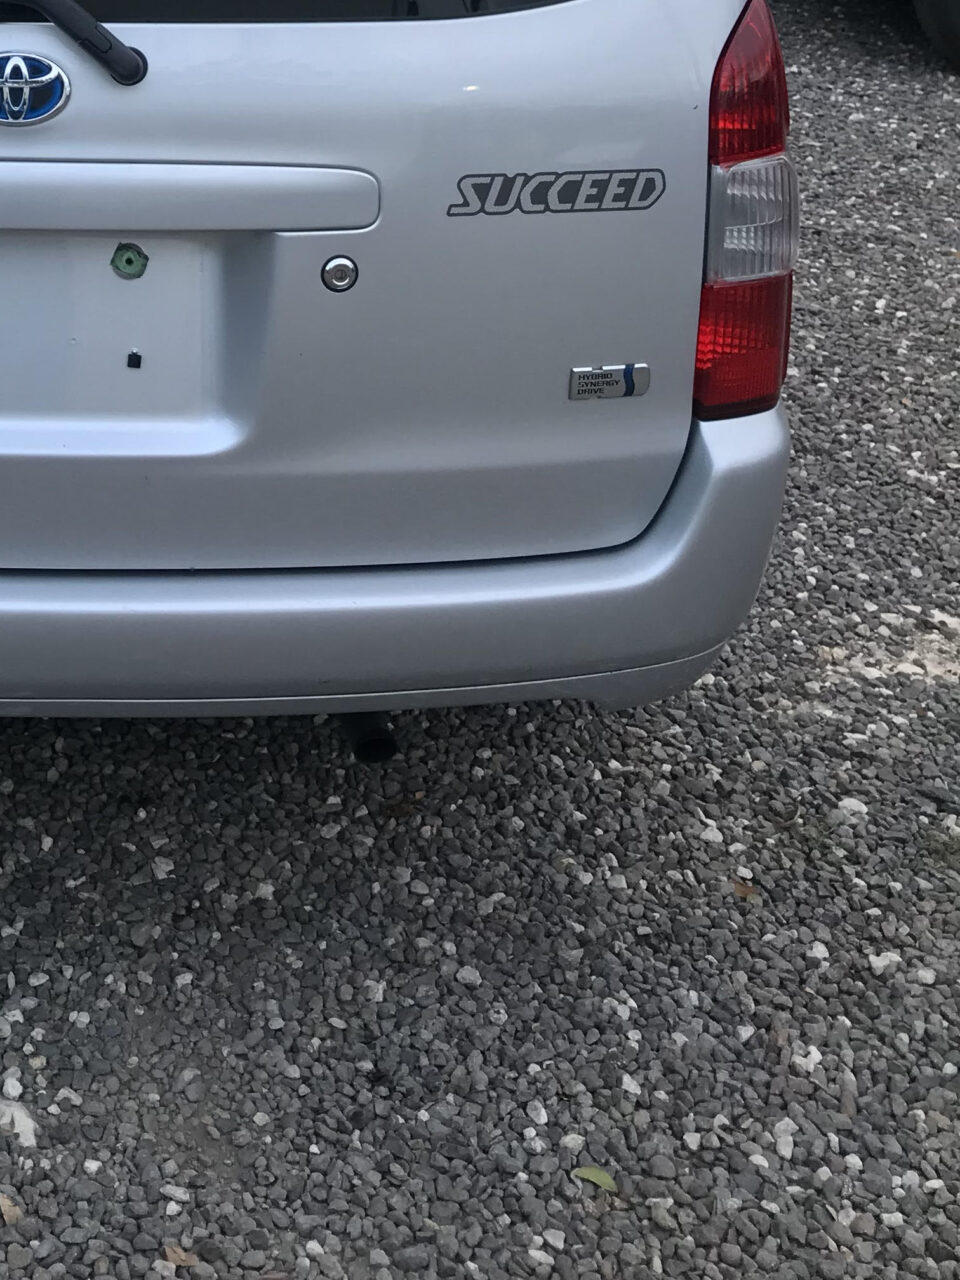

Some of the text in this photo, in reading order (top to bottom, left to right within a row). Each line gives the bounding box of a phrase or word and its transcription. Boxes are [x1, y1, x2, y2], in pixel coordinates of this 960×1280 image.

[447, 169, 666, 217] SUCCEED
[577, 372, 613, 381] HYBRID
[577, 380, 621, 388] SYNERGY
[577, 387, 605, 395] DRIVE
